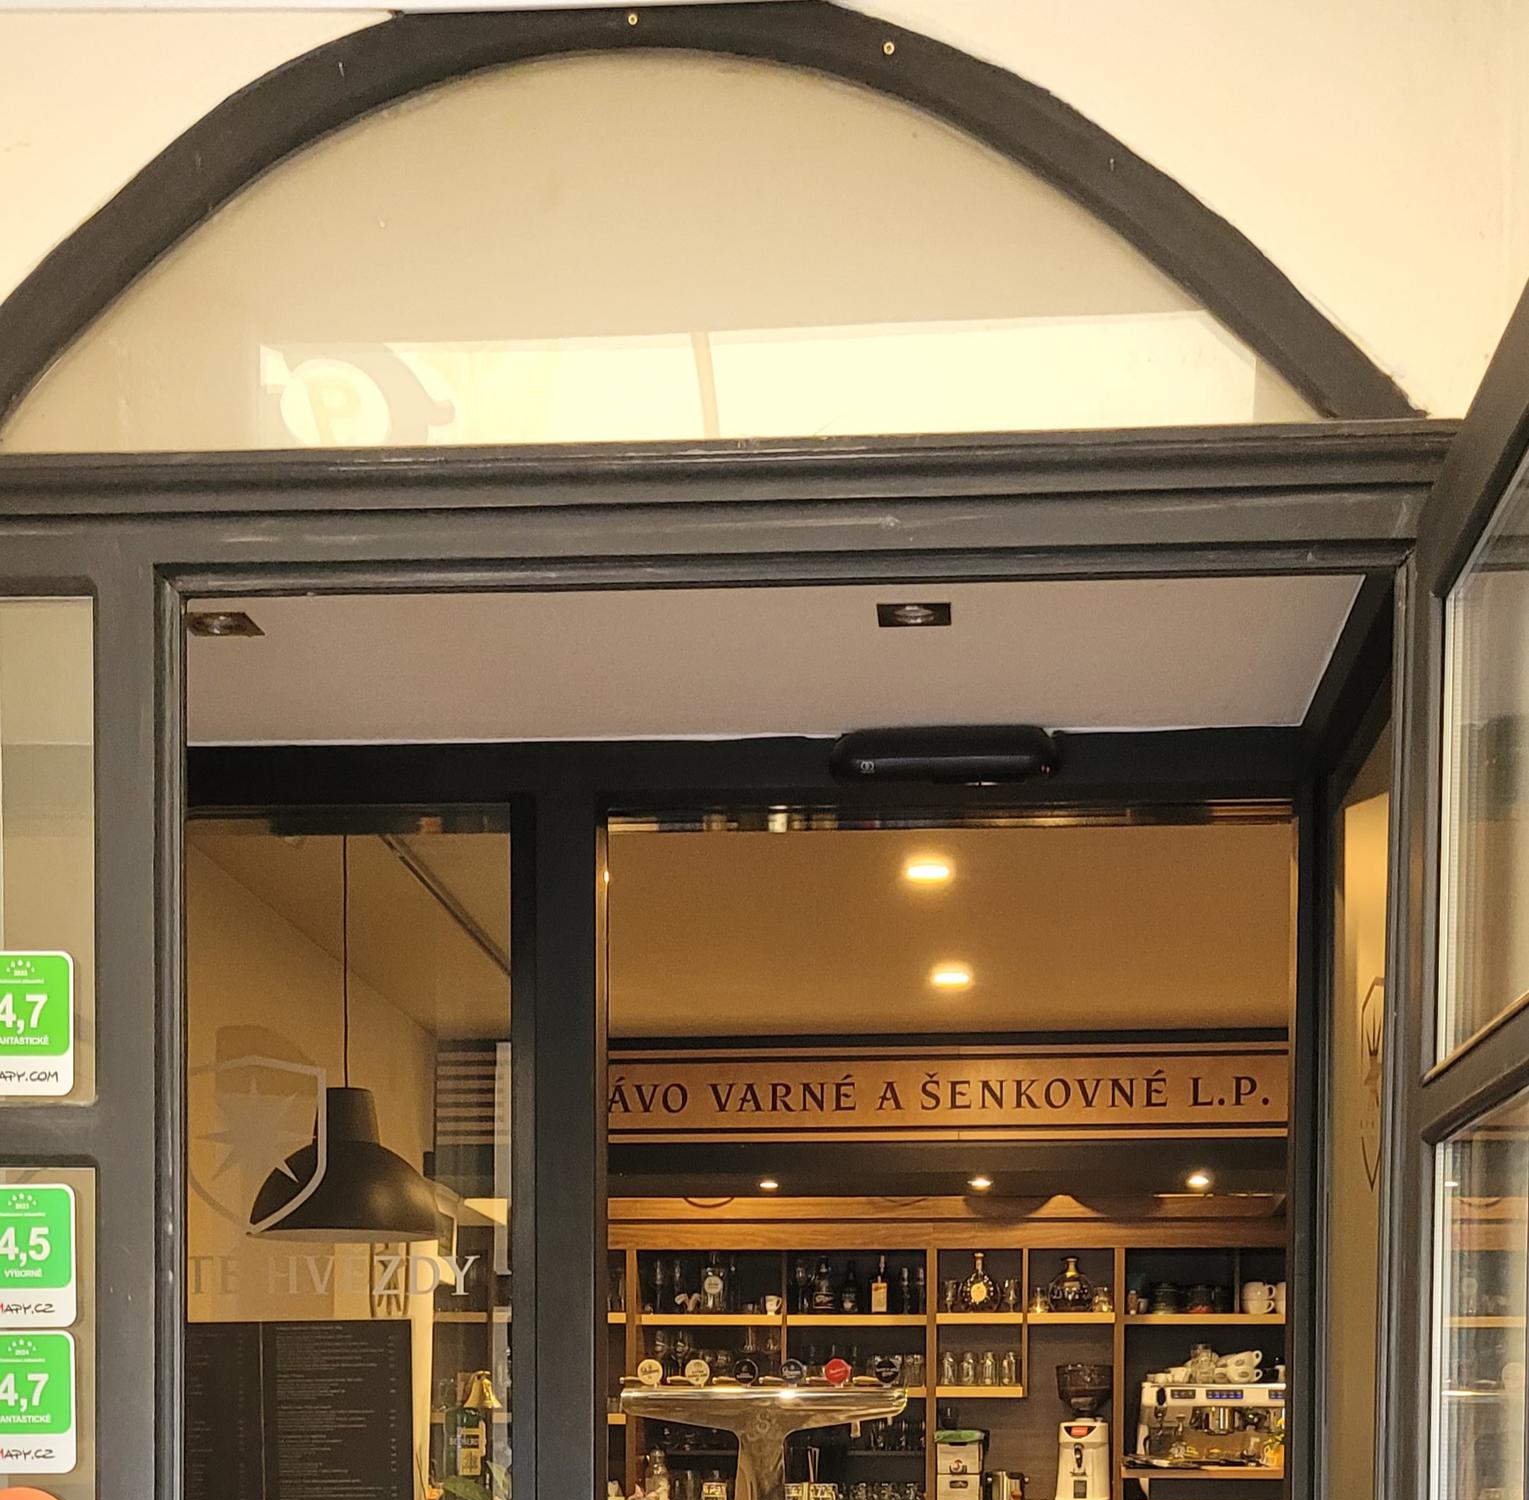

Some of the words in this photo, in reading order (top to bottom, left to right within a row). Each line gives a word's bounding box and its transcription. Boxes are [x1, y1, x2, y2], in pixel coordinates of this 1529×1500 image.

[0, 992, 48, 1034] 4,7
[608, 1076, 688, 1114] ÁVO
[708, 1073, 857, 1112] VARNÉ
[876, 1080, 905, 1111] A
[920, 1068, 1169, 1111] ŠENKOVNÉ
[1187, 1075, 1271, 1107] L.P.
[0, 1226, 51, 1266] 4,5
[0, 1373, 49, 1412] 4,7
